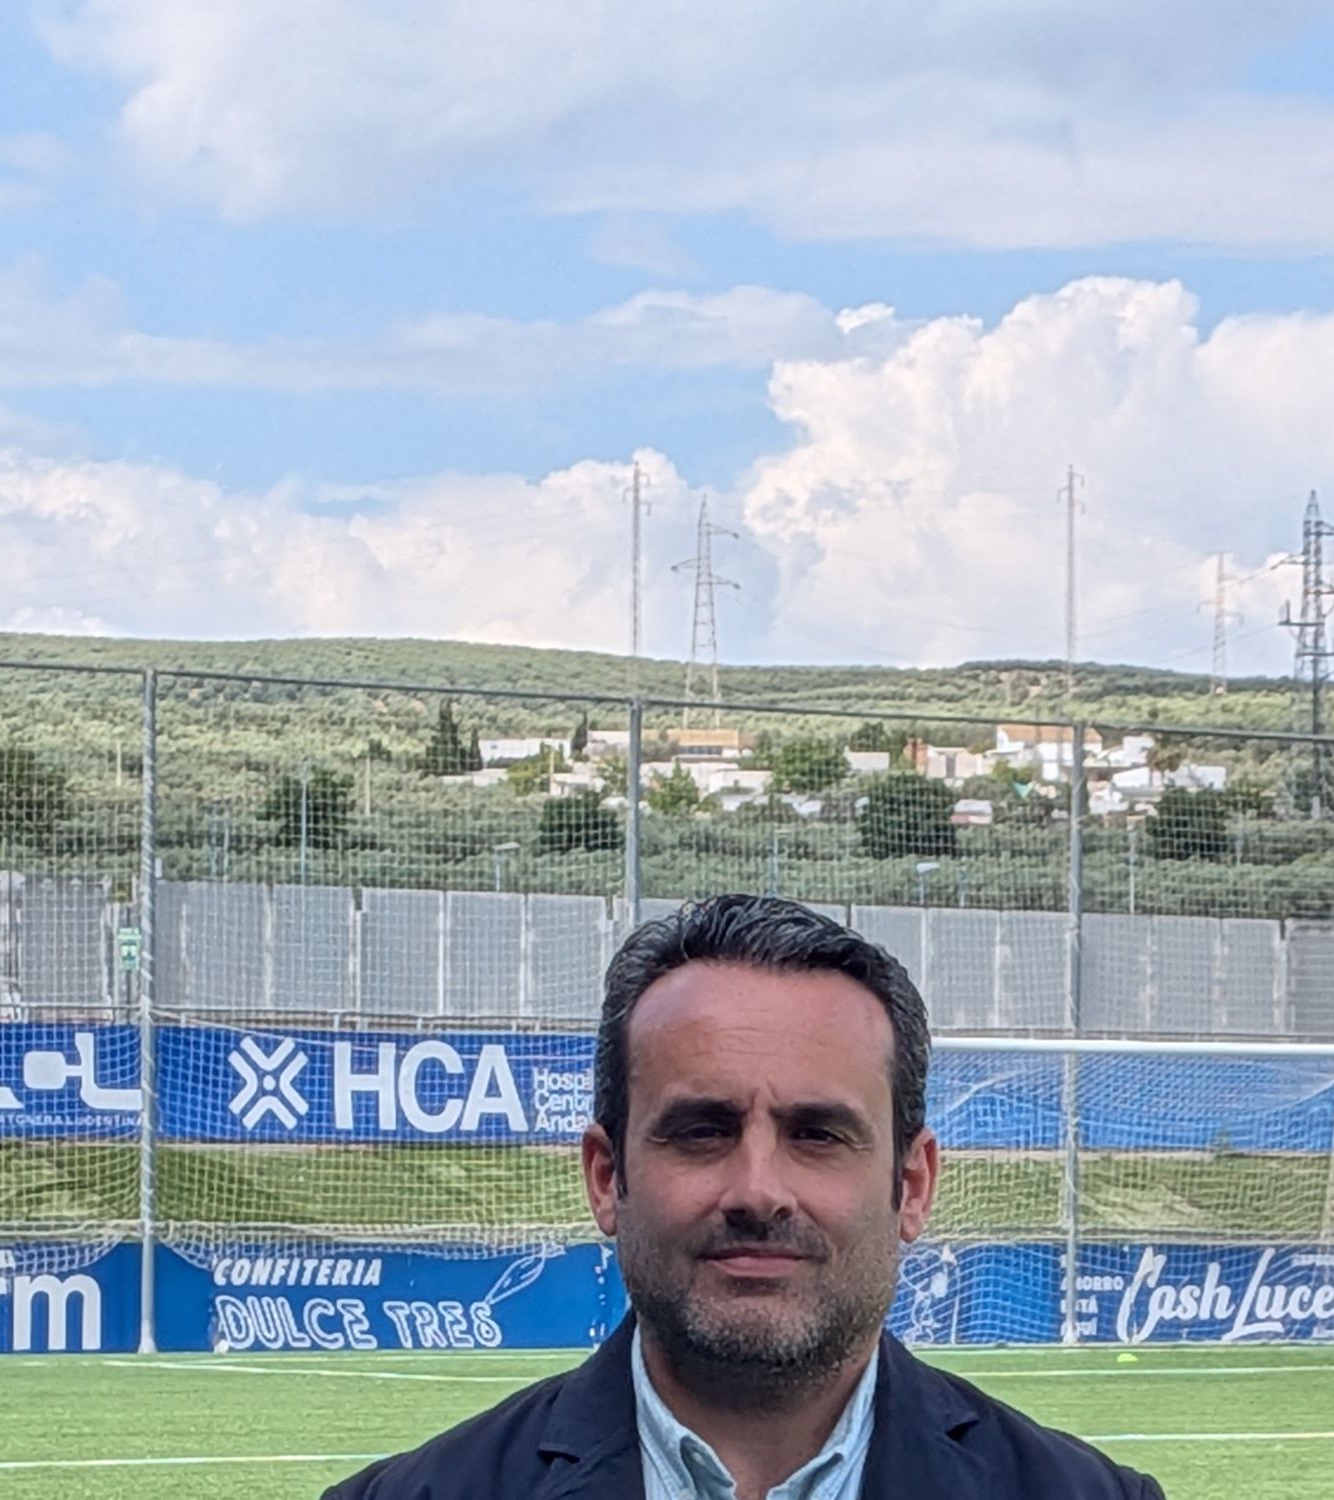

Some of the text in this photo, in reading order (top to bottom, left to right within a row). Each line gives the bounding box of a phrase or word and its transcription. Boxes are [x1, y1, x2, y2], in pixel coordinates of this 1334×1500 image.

[333, 1041, 529, 1133] HCA
[214, 1258, 382, 1287] CONFITERIA
[1117, 1246, 1236, 1344] Cash
[215, 1296, 502, 1350] DULCE TRES
